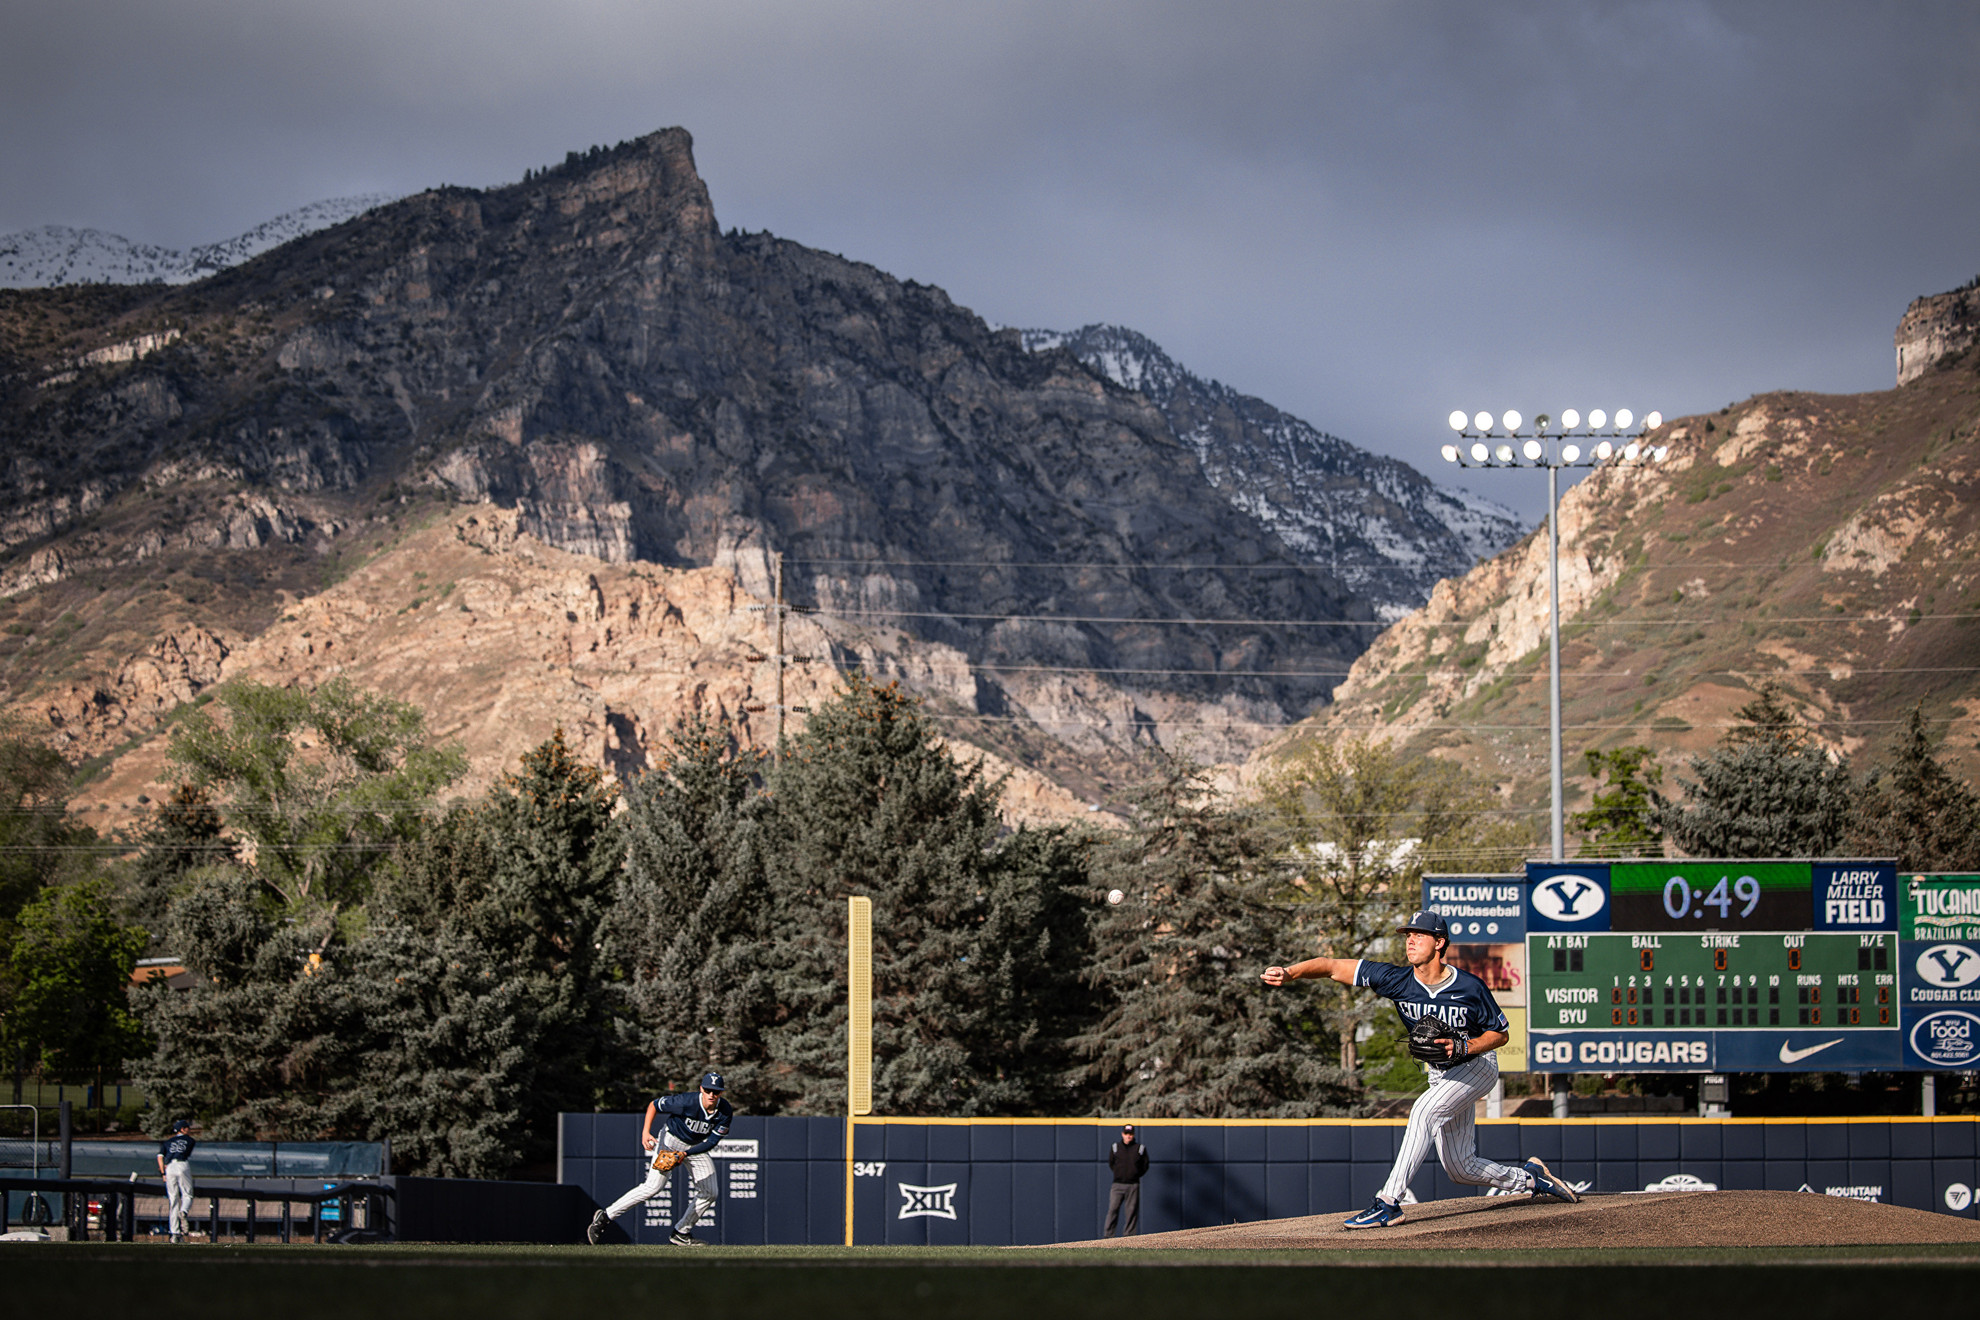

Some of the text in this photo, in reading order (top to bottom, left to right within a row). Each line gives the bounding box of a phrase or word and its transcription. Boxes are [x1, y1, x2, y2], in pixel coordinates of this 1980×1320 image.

[1831, 871, 1880, 885] LARRY
[1429, 886, 1519, 902] FOLLOW US
[1545, 881, 1591, 915] Y
[1662, 876, 1761, 919] 0:49
[1827, 885, 1884, 899] MILLER
[1411, 912, 1422, 925] Y
[1826, 900, 1885, 924] FIELD
[1547, 935, 1884, 948] AT BAT BALL STRIKE OUT H/E
[1914, 927, 1962, 941] BRAZILIAN
[1928, 949, 1971, 982] Y
[1628, 975, 1637, 987] 2
[1643, 975, 1652, 987] 3
[1665, 975, 1674, 987] 4
[1680, 975, 1689, 987] 5
[1696, 975, 1704, 987] 6
[1718, 975, 1726, 987] 7
[1733, 975, 1742, 987] 8
[1749, 975, 1757, 987] 9
[1769, 975, 1779, 987] 10
[1797, 975, 1822, 986] RUNS
[1838, 975, 1859, 986] HITS
[1875, 975, 1893, 986] ERR
[1545, 989, 1598, 1004] VISITOR
[1911, 988, 1957, 1002] COUGAR
[1559, 1009, 1587, 1024] BYU
[1930, 1020, 1970, 1039] Food
[1535, 1041, 1708, 1064] GO COUGARS
[710, 1075, 719, 1085] Y
[853, 1161, 886, 1177] 347
[1825, 1185, 1882, 1198] MOUNTAIN
